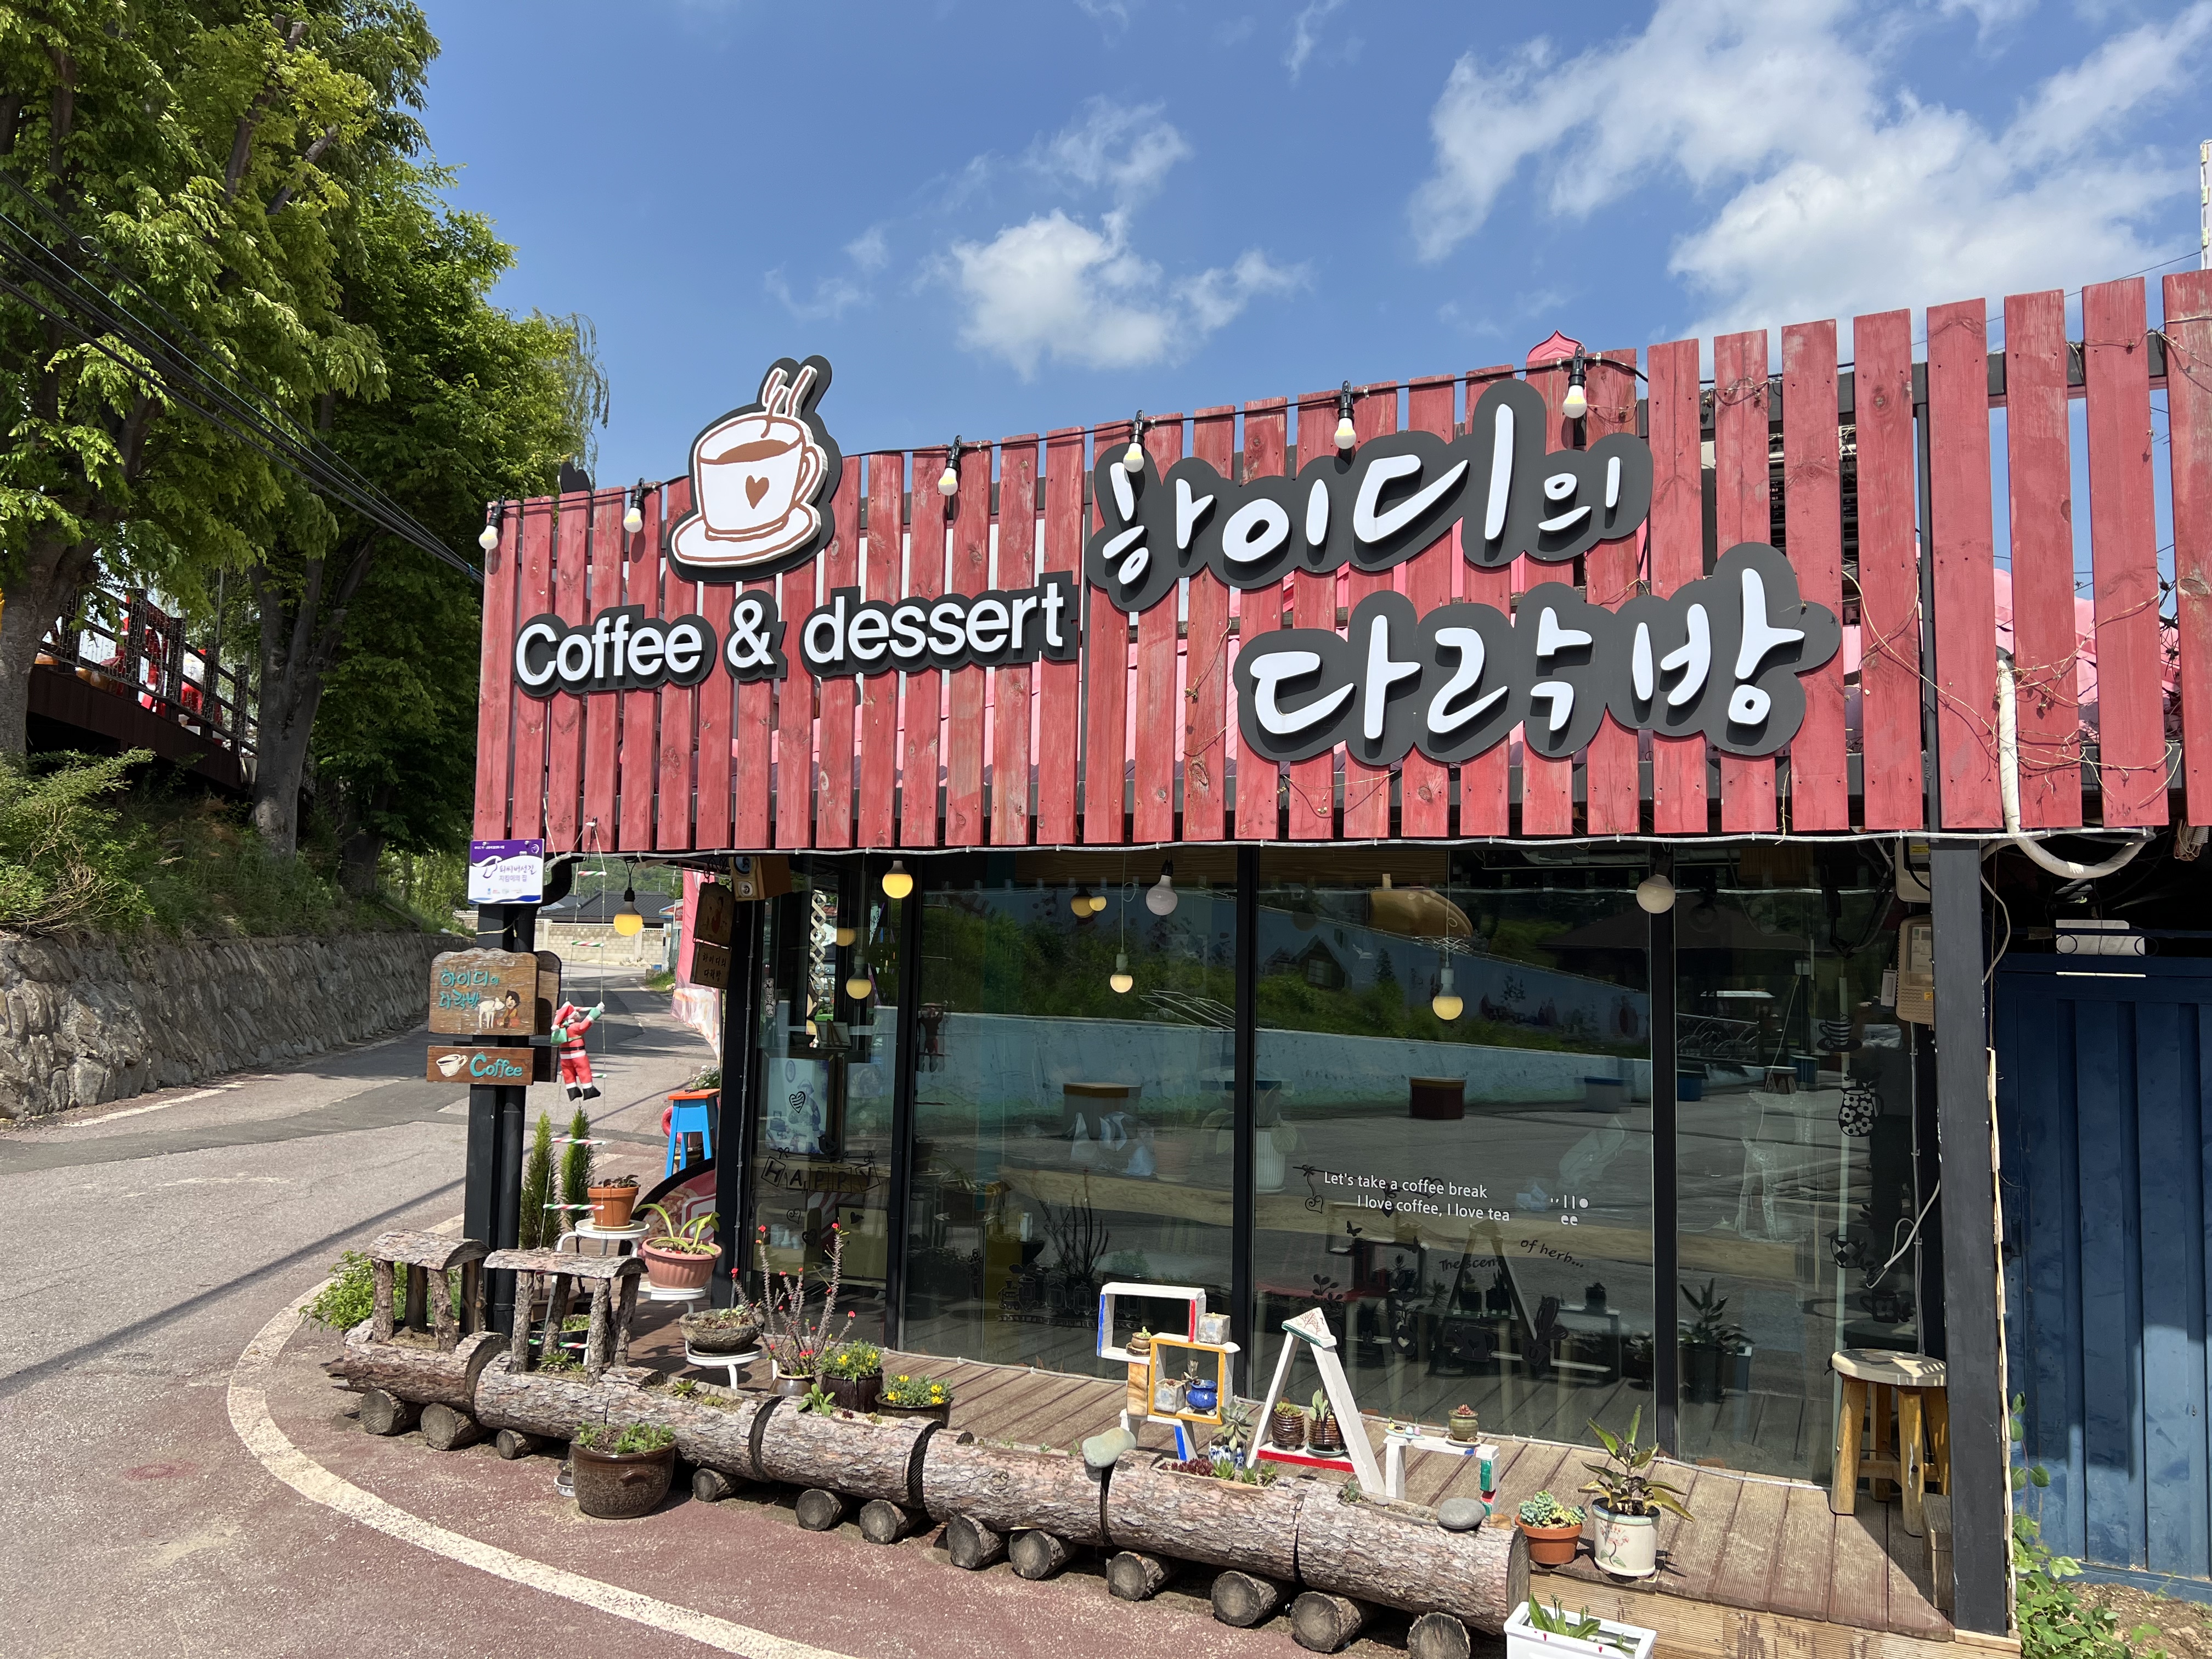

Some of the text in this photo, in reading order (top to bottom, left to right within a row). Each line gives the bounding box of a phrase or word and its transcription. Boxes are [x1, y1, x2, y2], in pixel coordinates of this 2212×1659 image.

[1103, 403, 1621, 585] 하이디의
[516, 582, 1063, 686] Coffee & dessert
[1250, 568, 1805, 740] 다락방
[499, 865, 537, 875] 외씨버선길
[702, 952, 727, 967] 하이디의
[441, 968, 500, 987] 하이디의
[703, 968, 722, 982] 다락방
[439, 989, 480, 1009] 다락방
[470, 1053, 523, 1078] Coffee
[1324, 1171, 1488, 1198] Let's take a coffee break
[1357, 1194, 1510, 1221] I love coffee, I love tea
[1520, 1239, 1538, 1254] of
[1440, 1259, 1460, 1272] The
